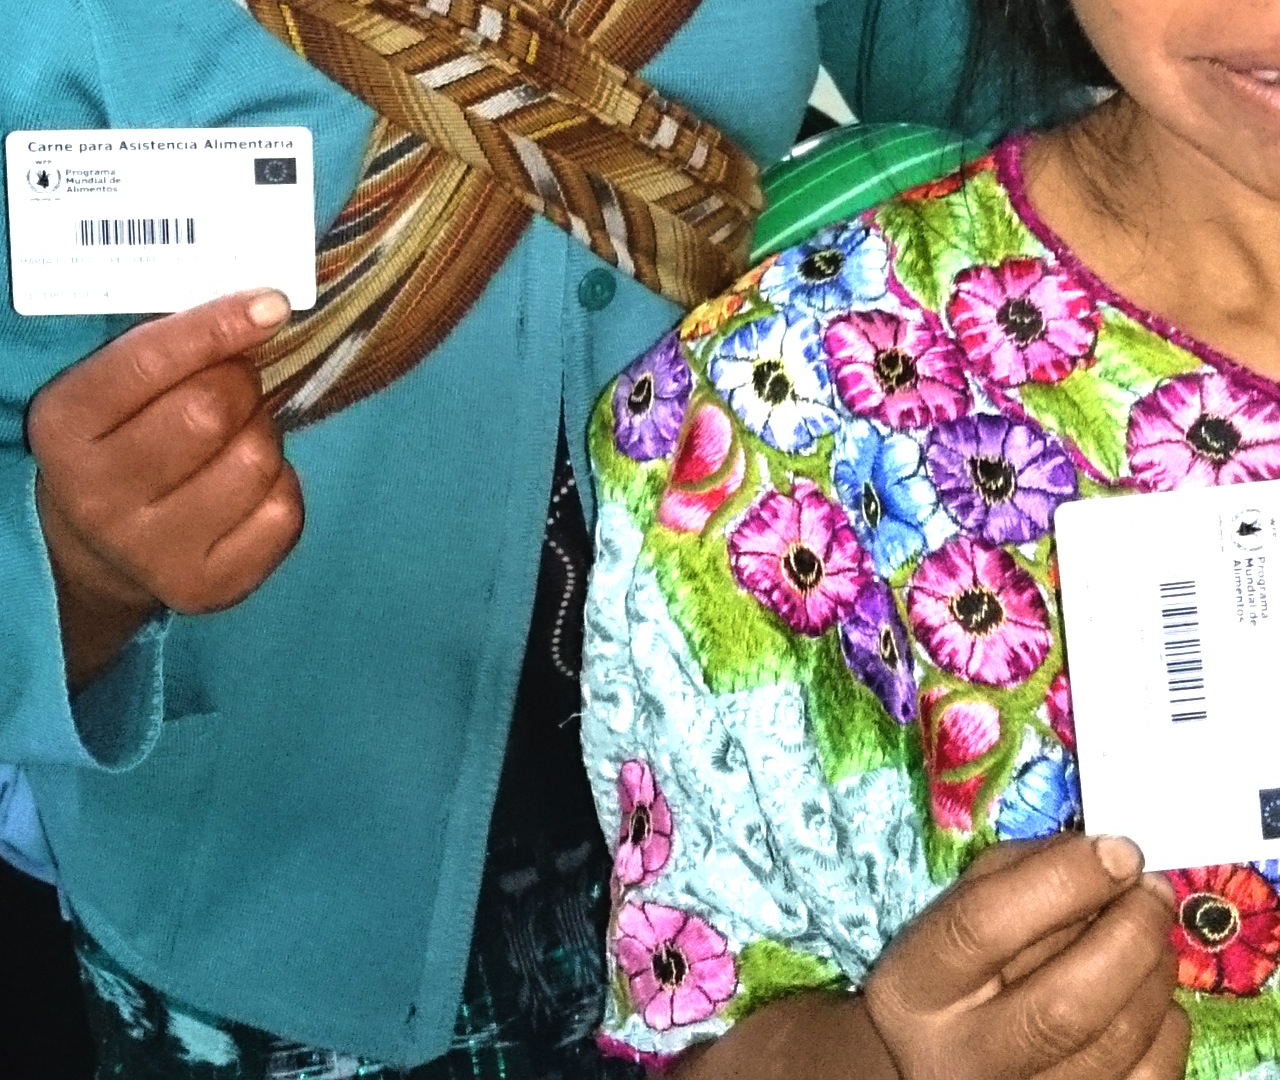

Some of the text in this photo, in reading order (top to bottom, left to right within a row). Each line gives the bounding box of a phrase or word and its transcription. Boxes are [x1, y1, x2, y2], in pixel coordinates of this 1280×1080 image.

[79, 141, 113, 154] para
[119, 140, 198, 151] Asistencia
[204, 138, 294, 150] Alimentaria
[65, 168, 116, 177] Programa
[66, 176, 122, 184] Mundial de
[66, 185, 118, 193] Alimentos
[1256, 555, 1270, 620] Programa
